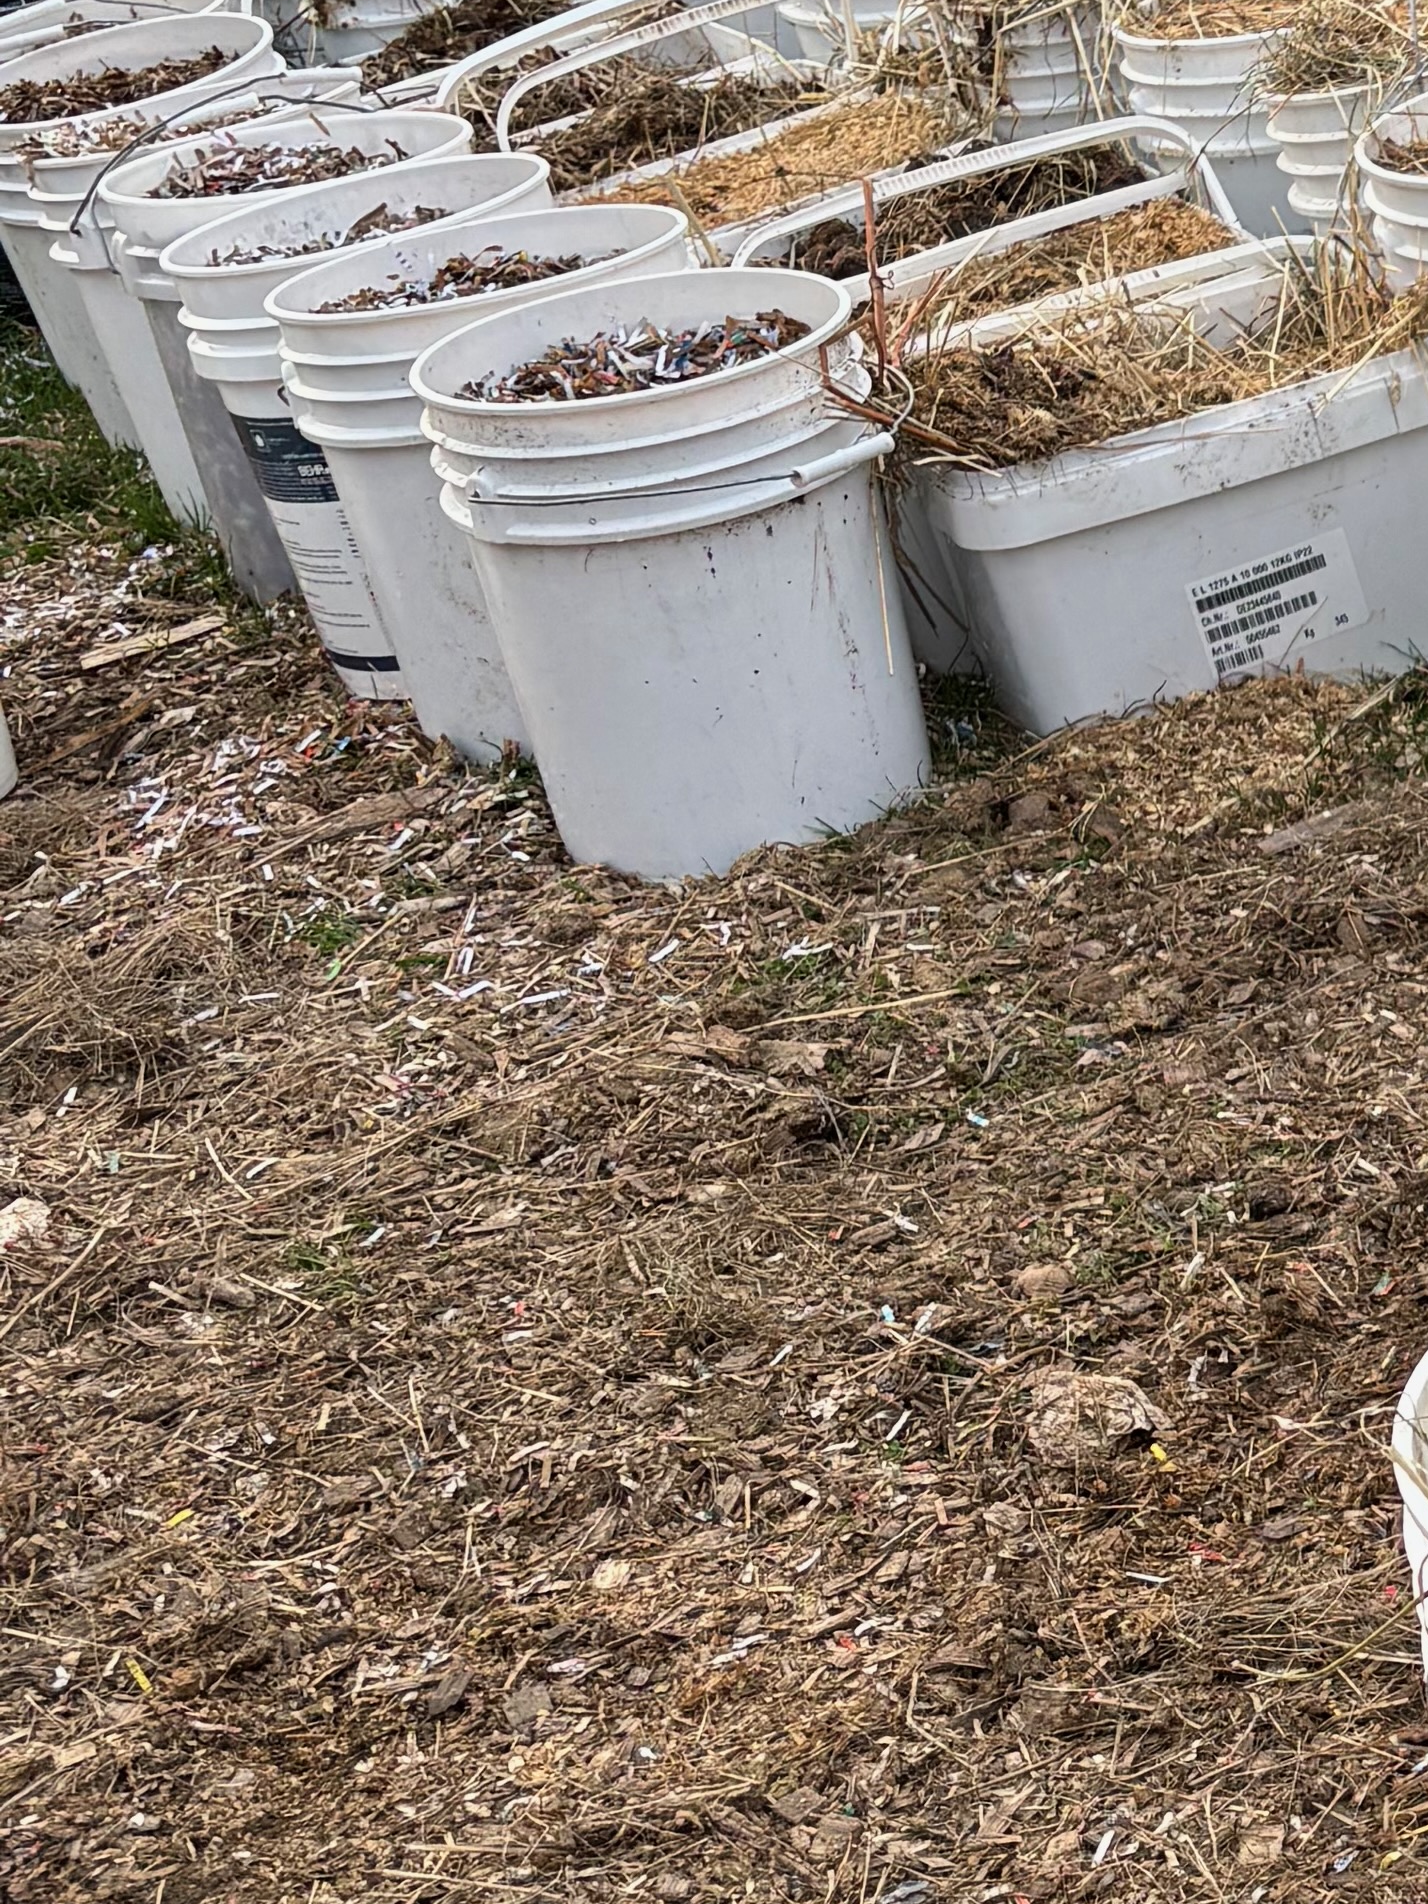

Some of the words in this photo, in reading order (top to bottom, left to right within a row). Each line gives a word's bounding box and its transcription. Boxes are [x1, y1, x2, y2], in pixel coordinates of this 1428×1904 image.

[1192, 588, 1198, 597] E
[1200, 586, 1206, 594] L
[1209, 577, 1230, 591] 1275
[1231, 574, 1238, 582] A
[1240, 569, 1251, 579] 10
